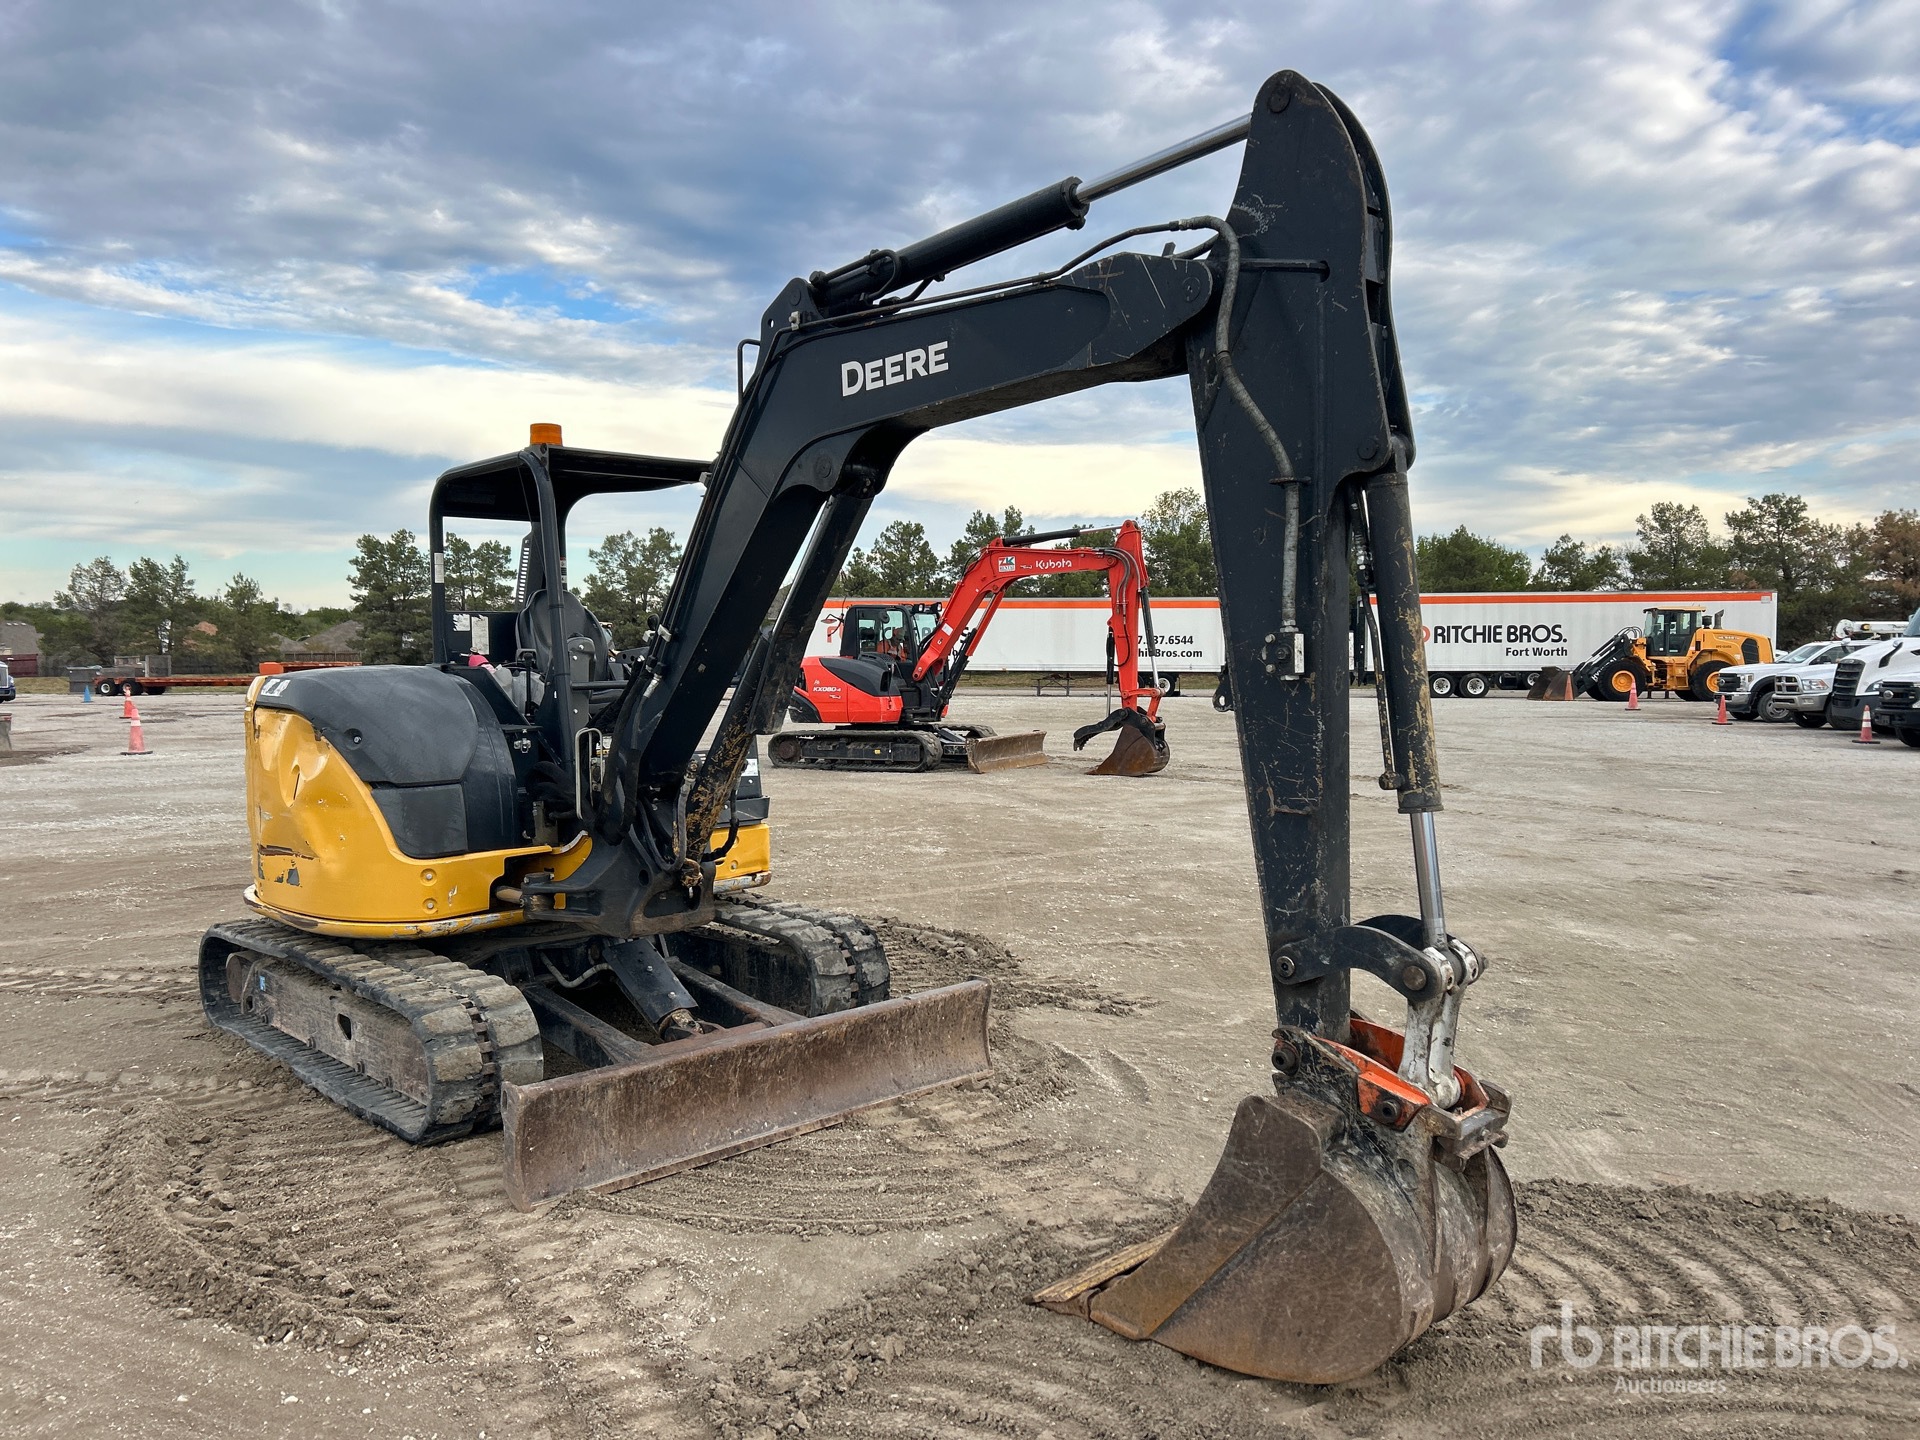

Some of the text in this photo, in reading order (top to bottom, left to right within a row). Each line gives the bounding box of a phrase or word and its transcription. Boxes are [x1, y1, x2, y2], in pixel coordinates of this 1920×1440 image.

[841, 340, 949, 397] DEERE
[1035, 558, 1072, 570] Kubota
[1433, 625, 1502, 644] RITCHIE
[1506, 624, 1568, 643] BROS.
[1138, 635, 1194, 645] 7.37.6544
[1138, 648, 1203, 657] hiBros.com
[1505, 647, 1568, 657] Fort Worth
